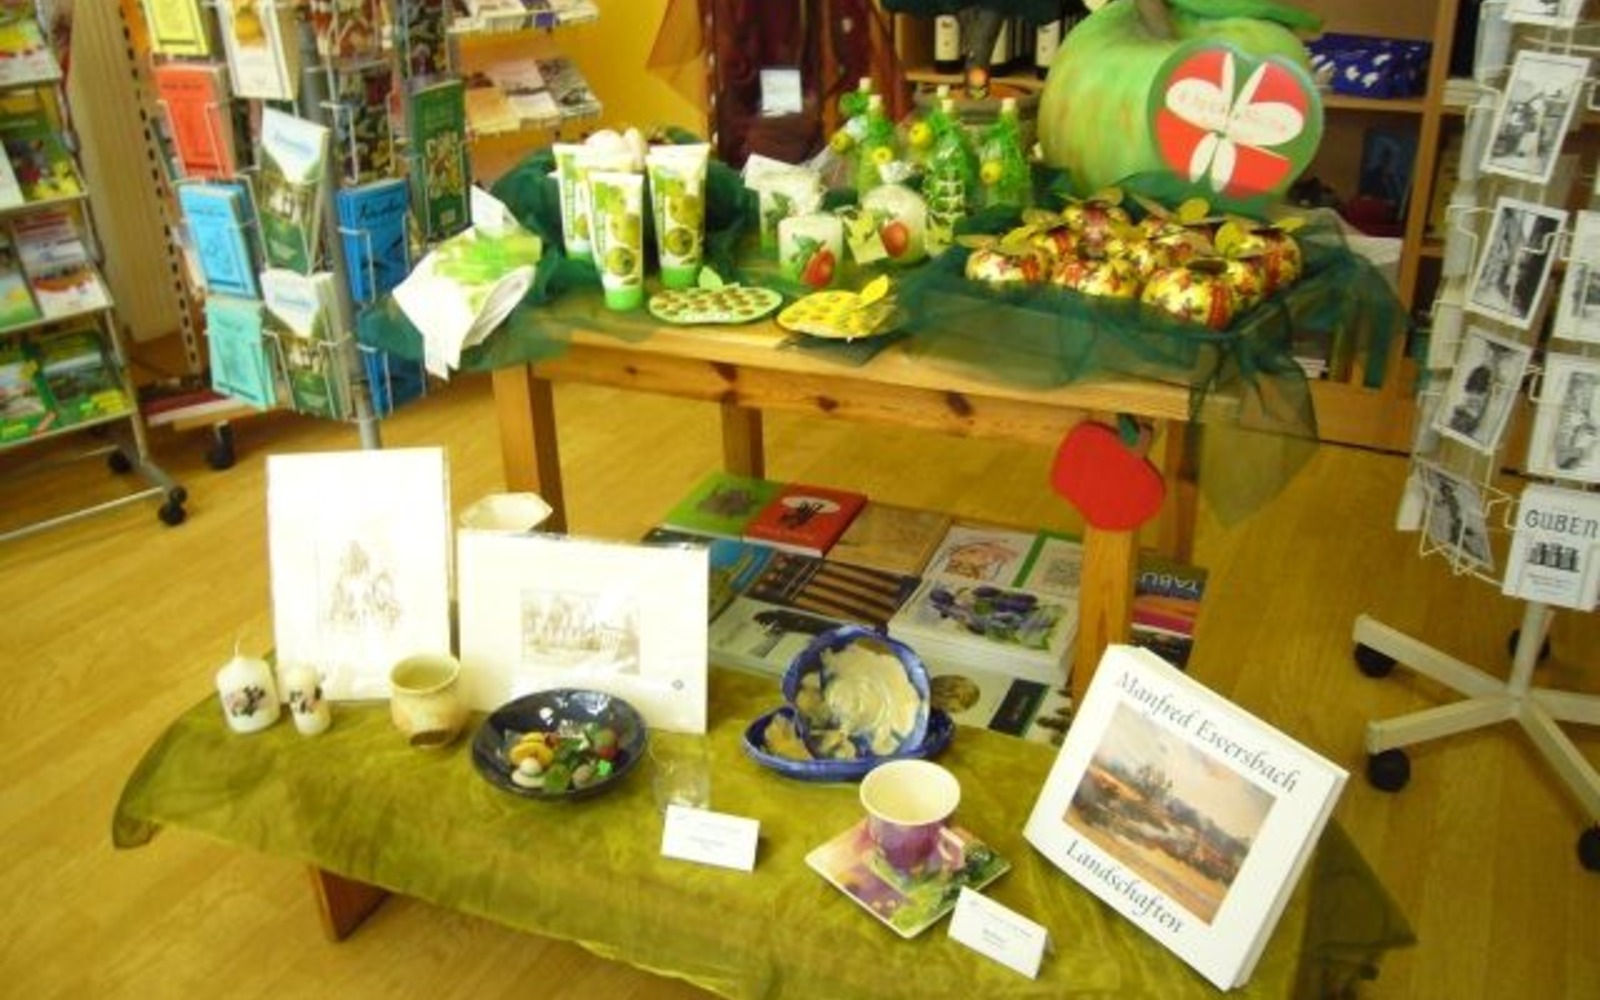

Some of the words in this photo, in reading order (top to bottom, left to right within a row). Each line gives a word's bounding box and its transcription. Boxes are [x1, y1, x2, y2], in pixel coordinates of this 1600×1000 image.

[1524, 508, 1598, 539] GUBEN
[1116, 671, 1200, 728] Manfred
[1196, 718, 1301, 793] Ewersbach
[1066, 839, 1183, 933] Landschaften
